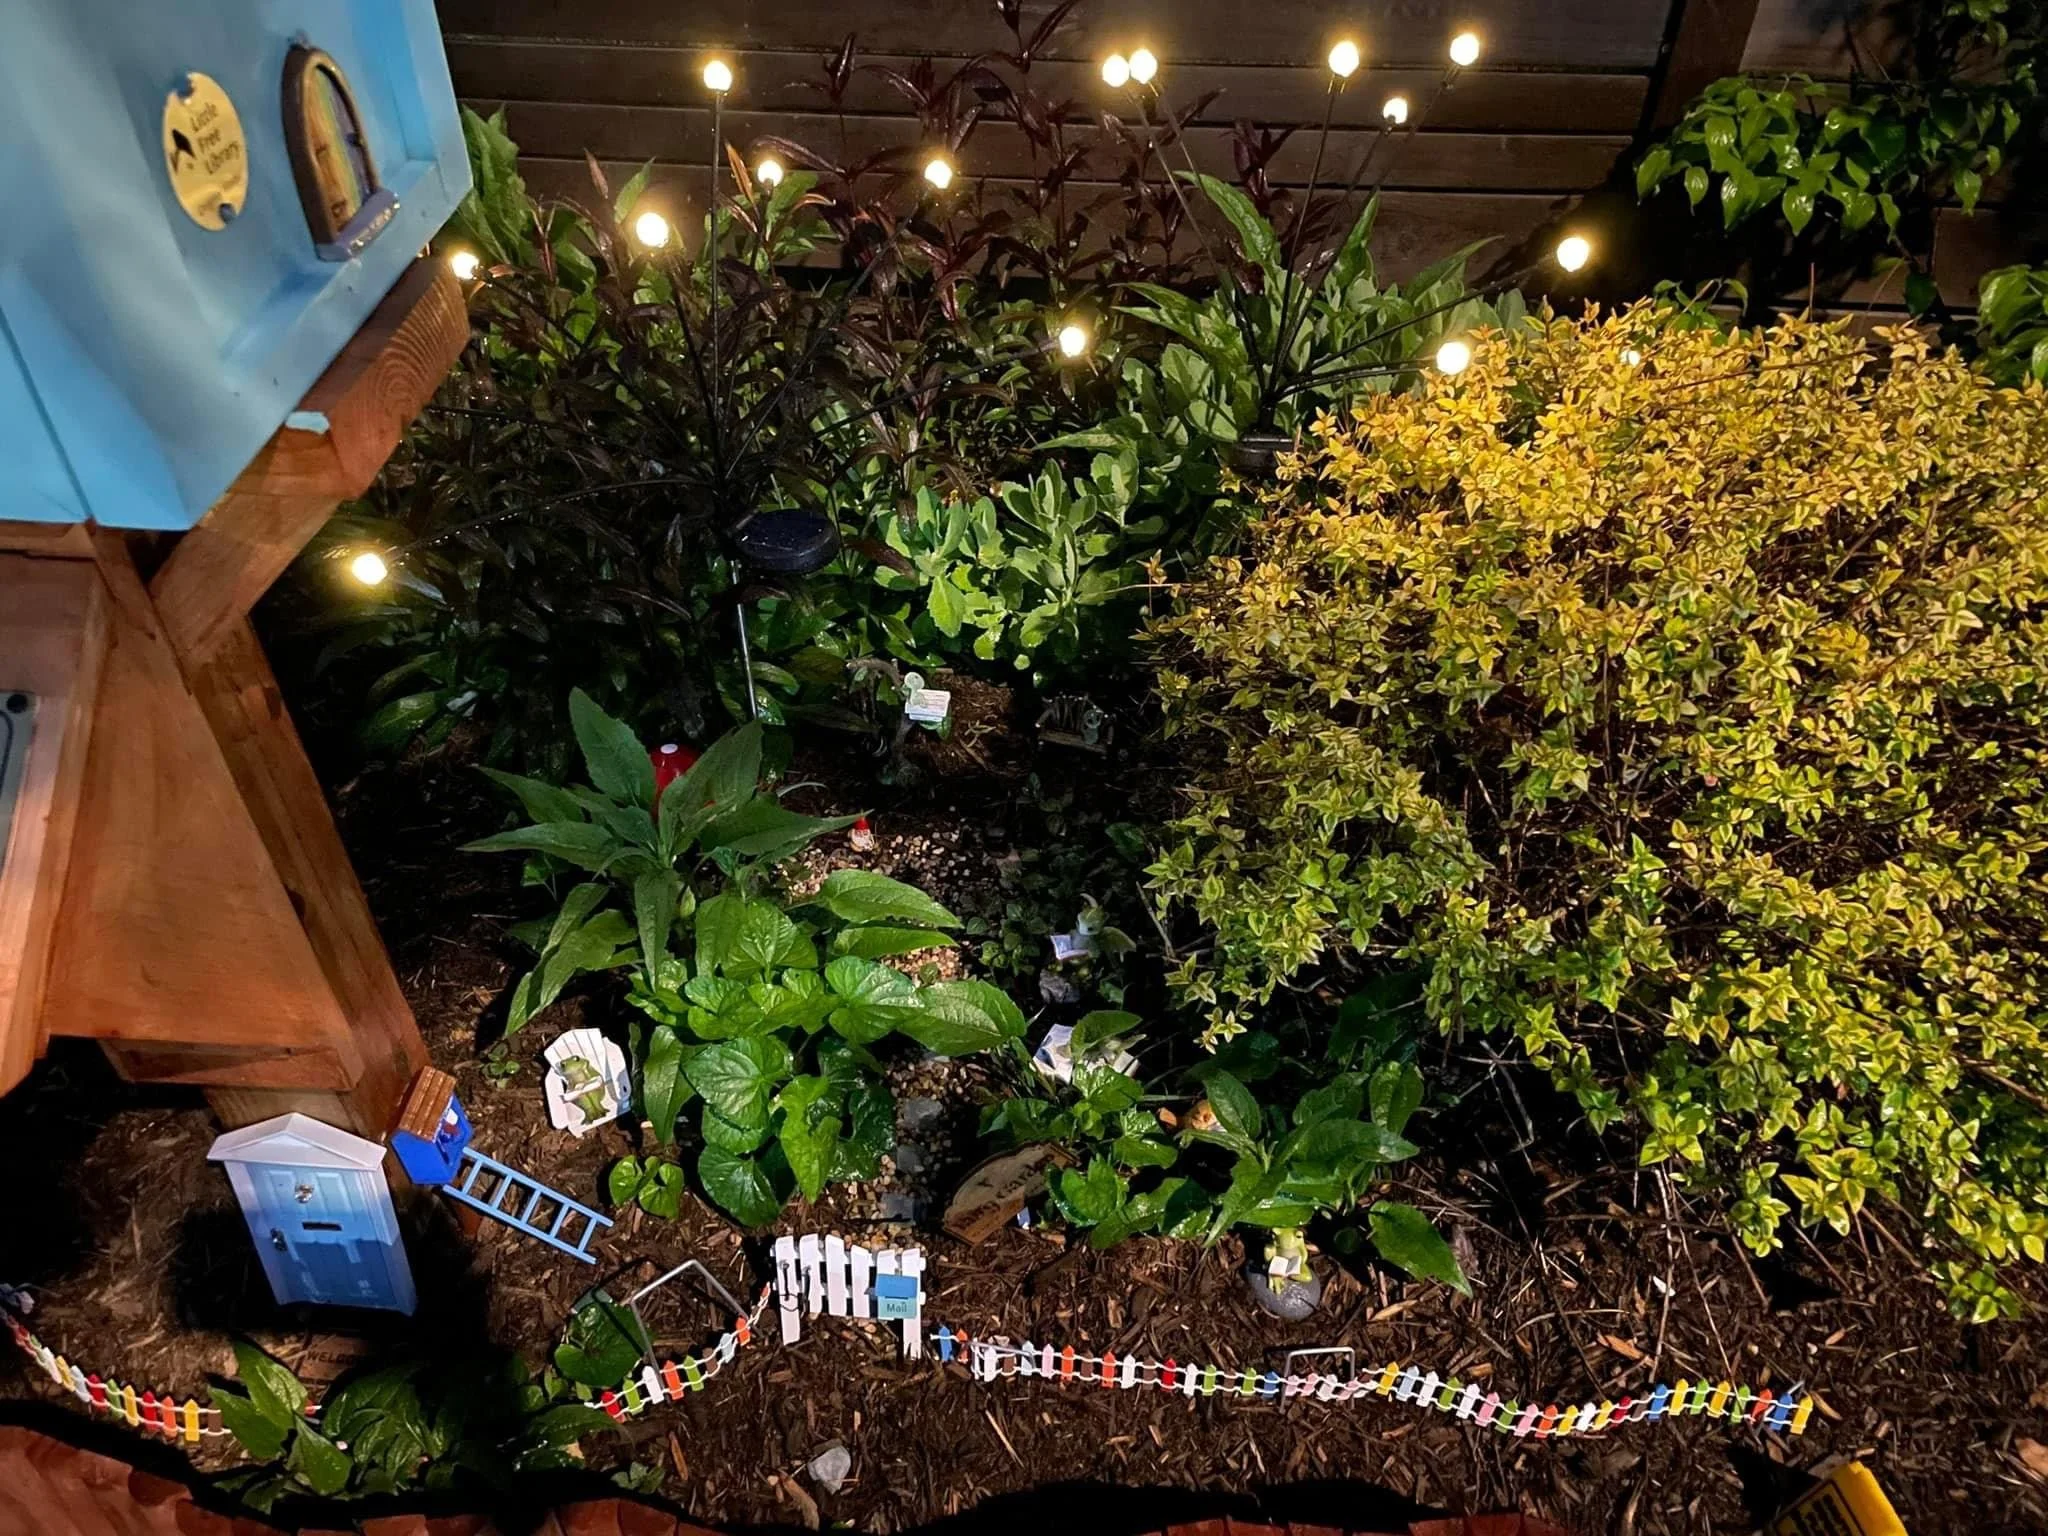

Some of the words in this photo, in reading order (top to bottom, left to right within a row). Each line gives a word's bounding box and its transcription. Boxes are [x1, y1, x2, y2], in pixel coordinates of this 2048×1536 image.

[190, 102, 218, 132] Little
[197, 128, 221, 154] Free
[205, 140, 240, 175] Library
[886, 1301, 908, 1313] Mail
